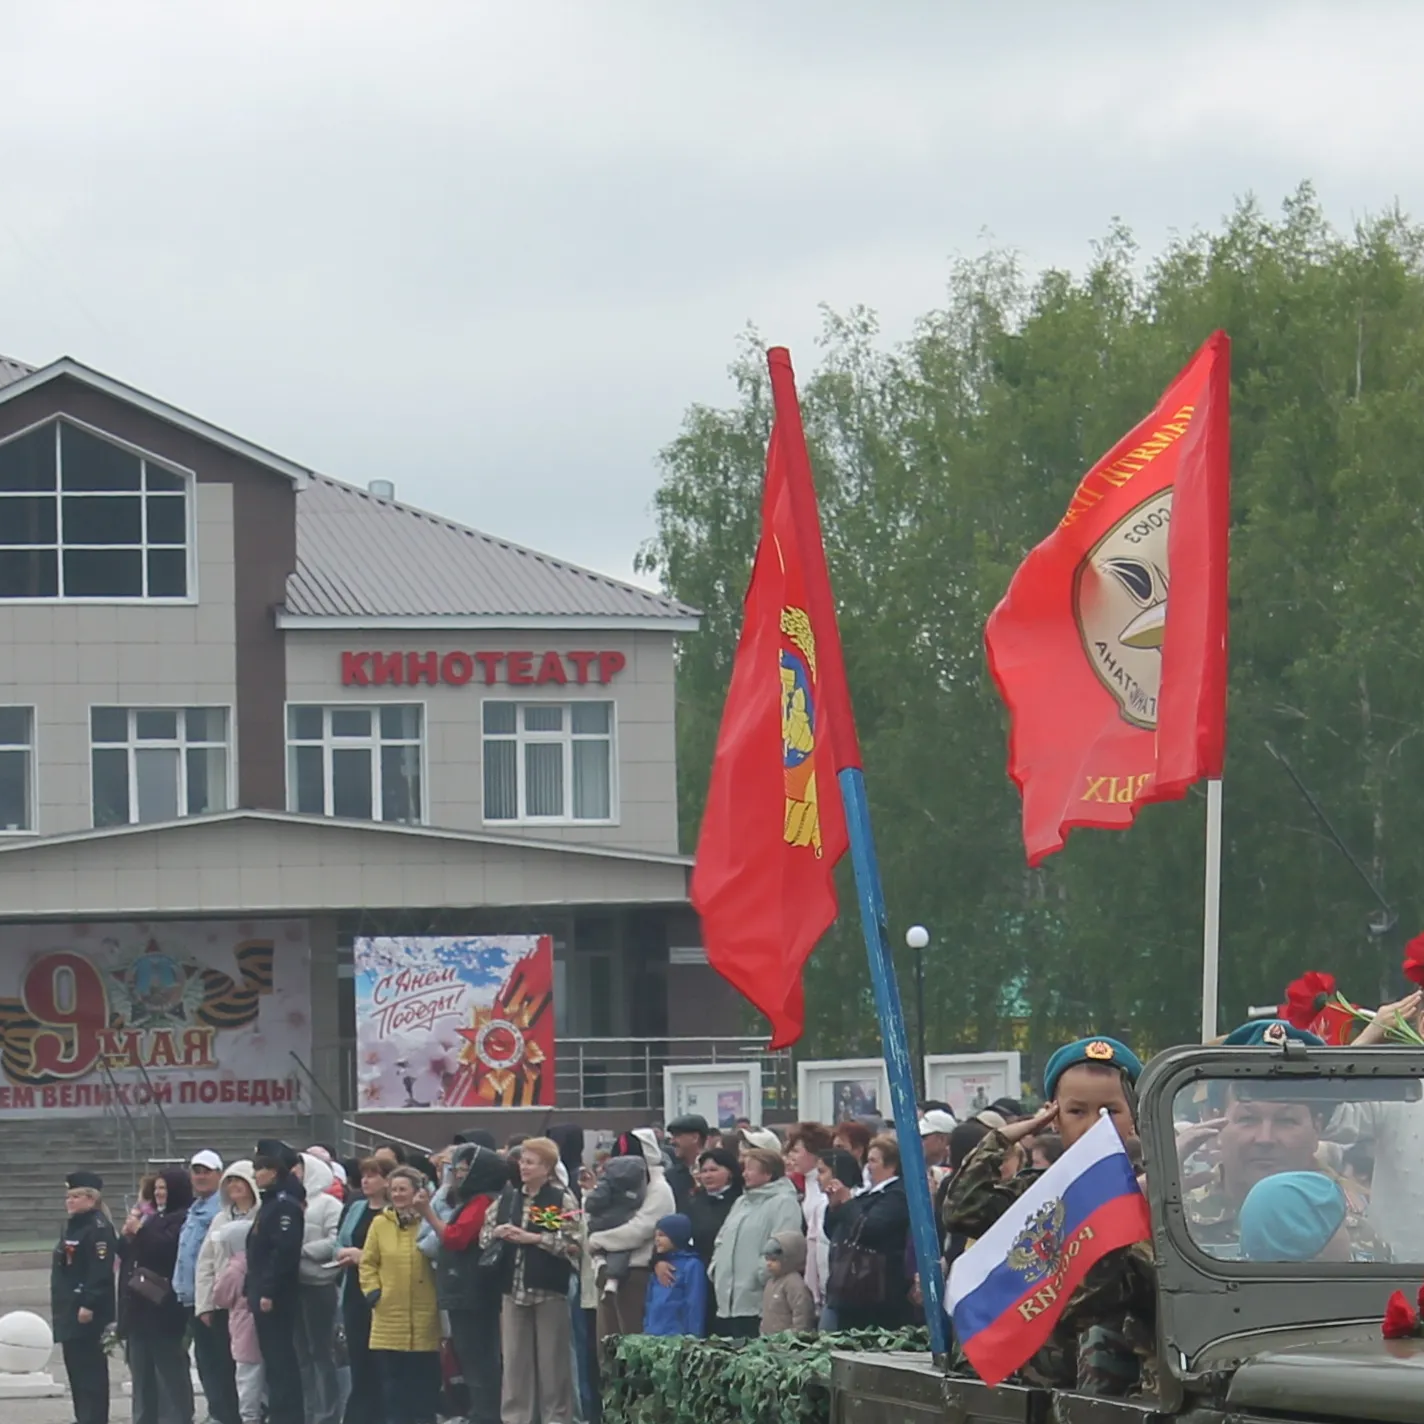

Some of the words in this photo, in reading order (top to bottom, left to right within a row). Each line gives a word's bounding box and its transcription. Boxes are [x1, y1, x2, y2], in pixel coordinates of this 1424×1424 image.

[340, 650, 627, 687] КИНОТЕАТР
[373, 974, 393, 1006] С
[395, 967, 457, 997] Днем
[22, 951, 110, 1078] 9
[96, 1026, 217, 1071] МАЯ
[371, 988, 466, 1040] Победы!
[42, 1077, 174, 1107] ВЕЛИКОЙ
[179, 1077, 302, 1107] ПОБЕДЫ!
